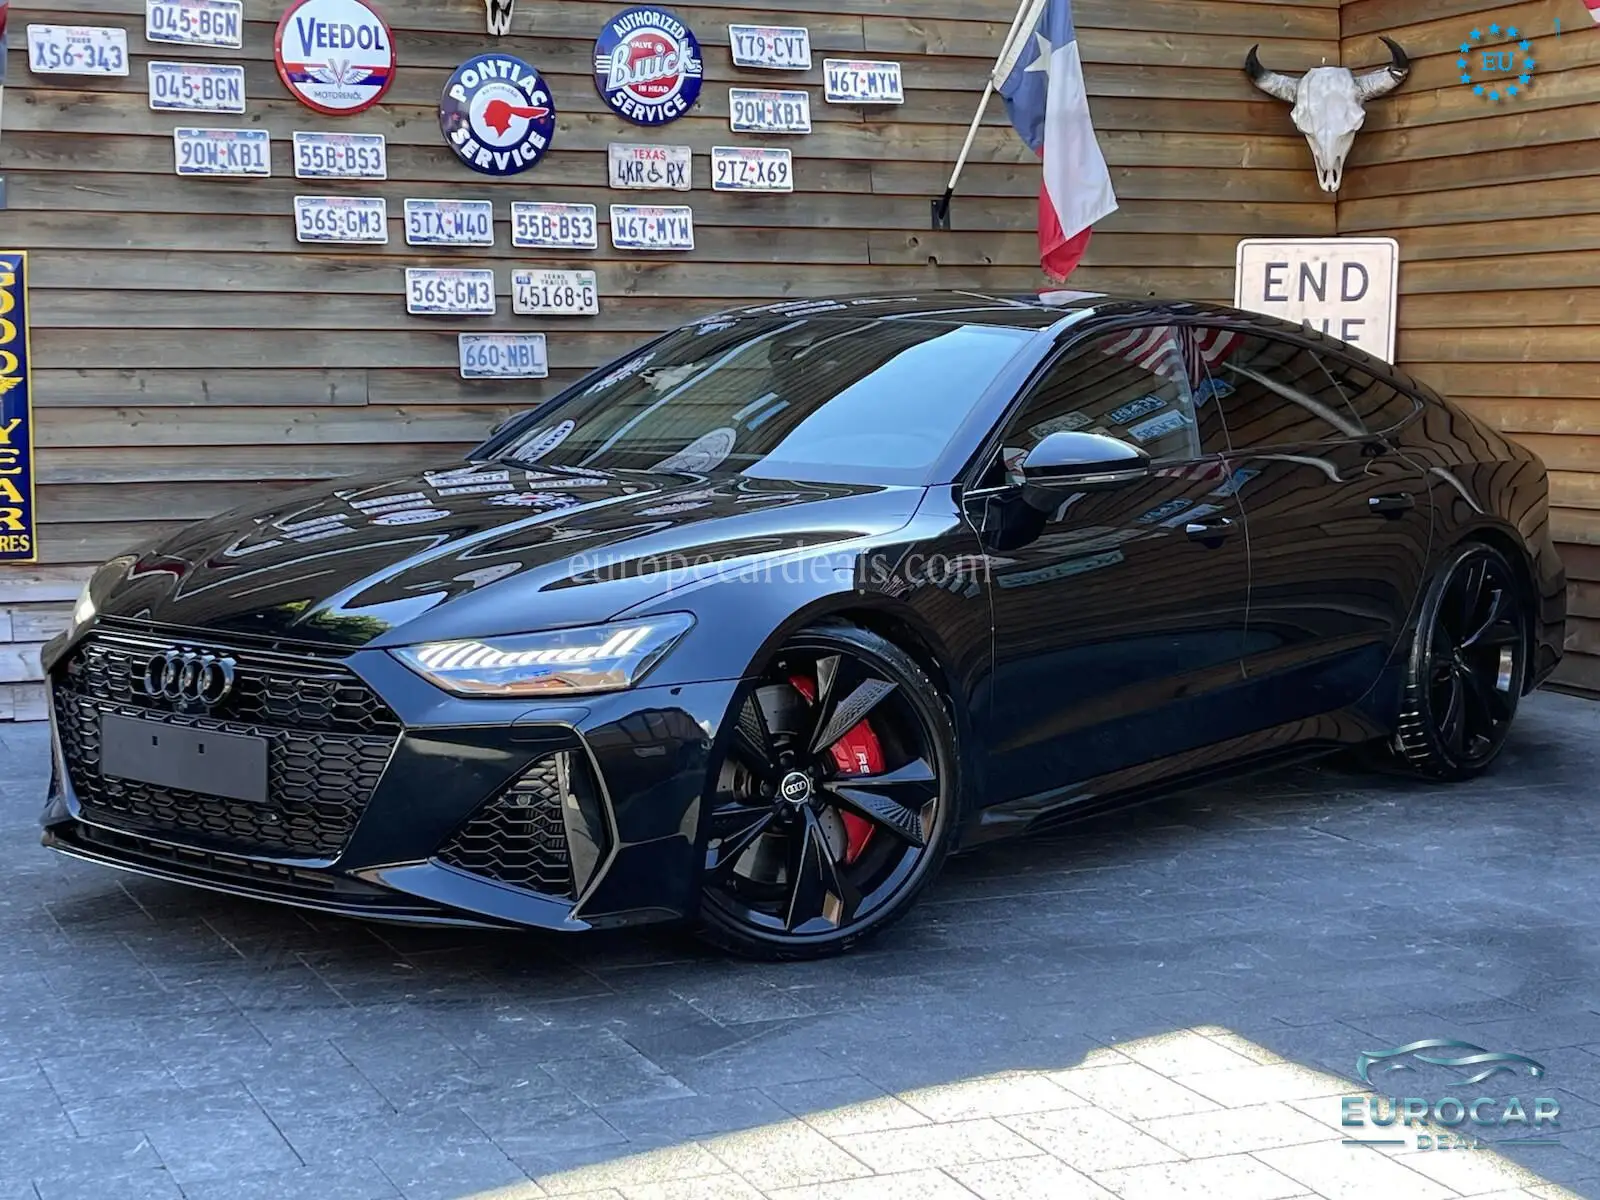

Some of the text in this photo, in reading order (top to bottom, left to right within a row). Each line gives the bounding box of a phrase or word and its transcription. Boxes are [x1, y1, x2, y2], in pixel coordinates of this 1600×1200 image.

[296, 17, 384, 56] VEEDOL
[613, 11, 686, 39] AUTHORIZED
[630, 41, 653, 49] VALVE
[606, 38, 700, 92] Buick
[449, 60, 547, 106] PONTIAC
[611, 92, 687, 122] SERVICE
[451, 128, 546, 170] SERVICE
[633, 149, 666, 161] TEXAS
[618, 160, 685, 183] 4KR RX
[520, 286, 574, 307] 45168
[1264, 262, 1369, 302] END
